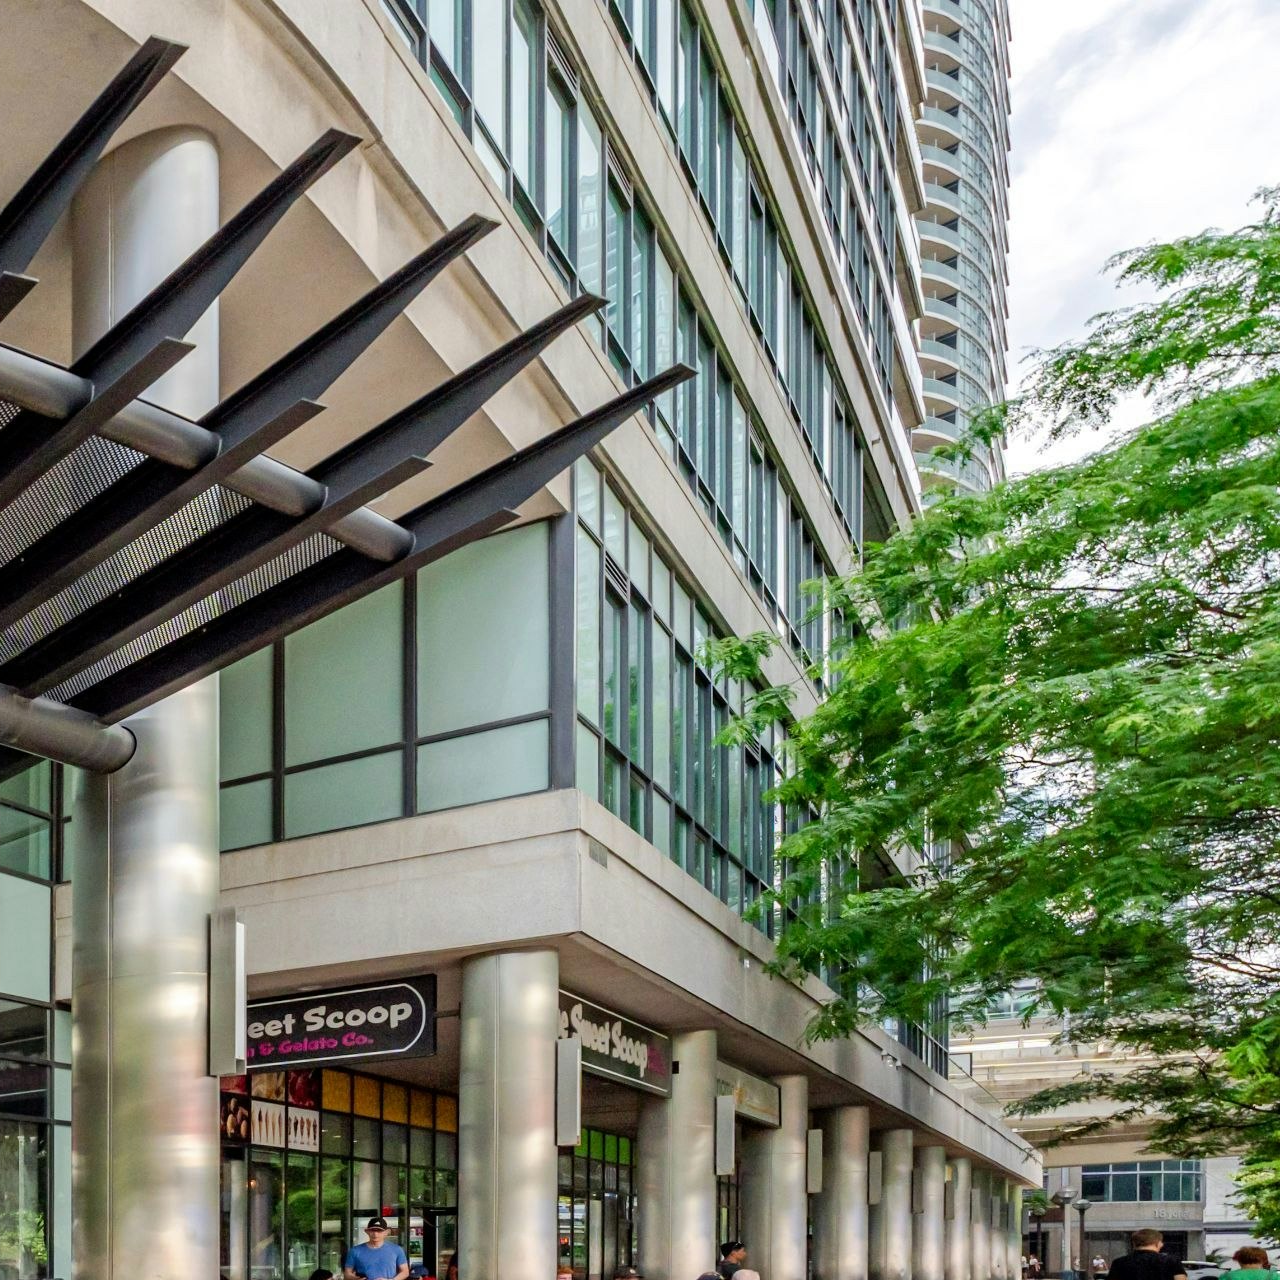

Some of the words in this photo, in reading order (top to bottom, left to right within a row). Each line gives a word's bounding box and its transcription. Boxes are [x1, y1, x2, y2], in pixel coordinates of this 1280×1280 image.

[247, 1013, 296, 1039] eet
[303, 1002, 413, 1032] Scoop
[278, 1036, 338, 1054] Gelato
[342, 1032, 374, 1047] Co.
[611, 1020, 648, 1078] Scoop
